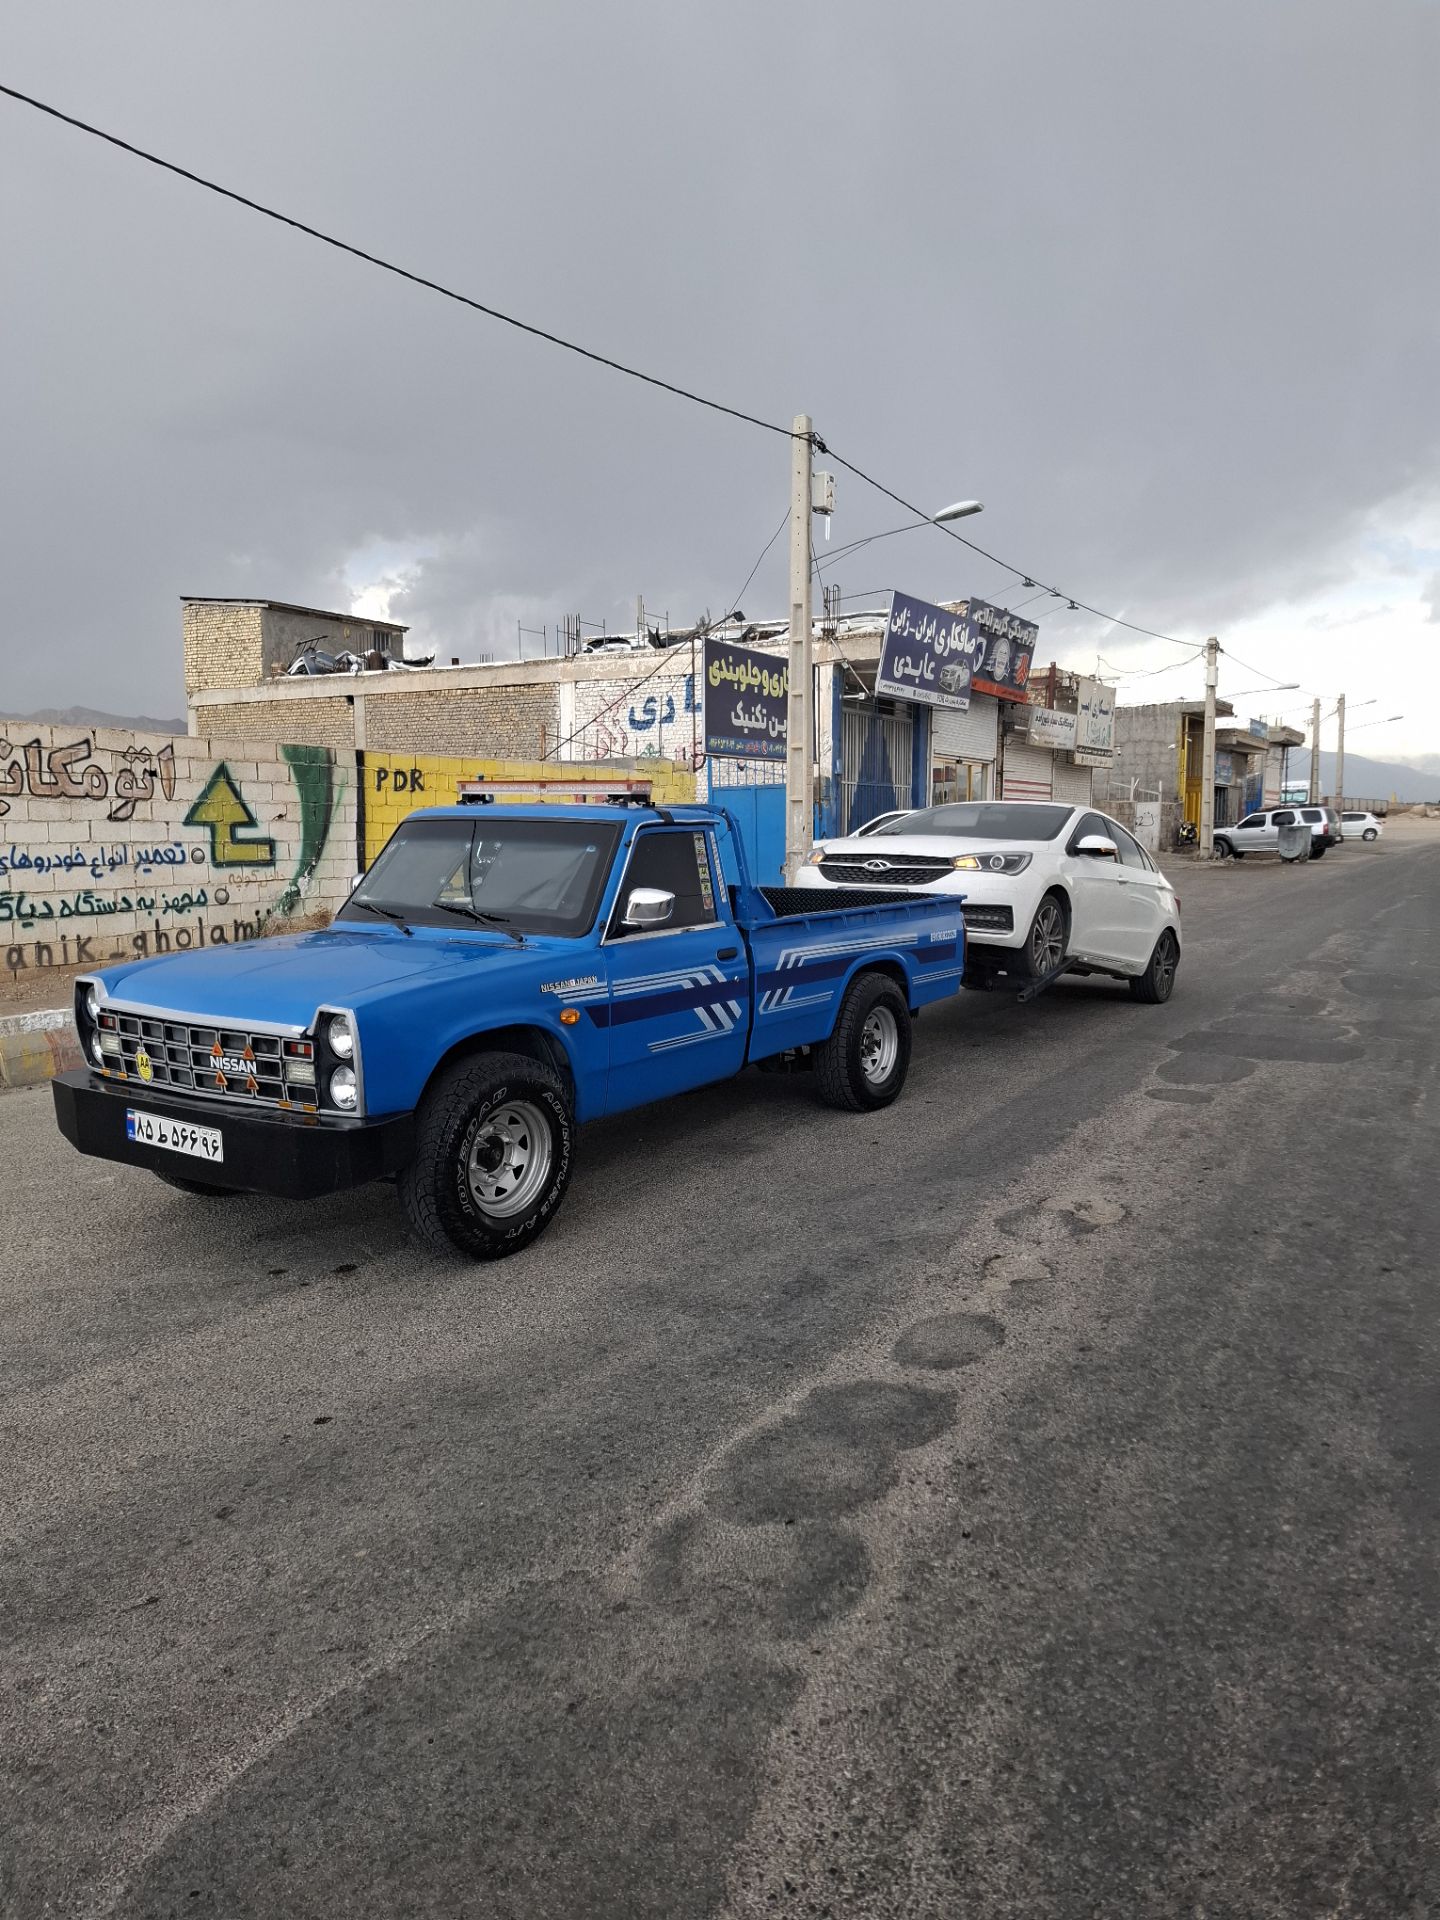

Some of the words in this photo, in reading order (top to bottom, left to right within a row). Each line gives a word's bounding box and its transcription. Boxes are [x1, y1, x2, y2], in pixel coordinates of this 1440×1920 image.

[934, 621, 976, 657] صافکاری
[709, 656, 761, 693] جلوبندی
[893, 652, 936, 684] عابدی
[762, 669, 769, 696] و
[731, 700, 767, 734] تکنیک
[376, 767, 425, 792] PDR
[91, 844, 128, 878] انواع
[134, 842, 186, 873] تعمیر
[60, 890, 133, 917] دستگاه
[137, 896, 155, 916] به
[162, 889, 208, 914] مجهز
[541, 980, 570, 993] NISSAN
[575, 975, 598, 986] JAPAN
[210, 1056, 257, 1074] NISSAN
